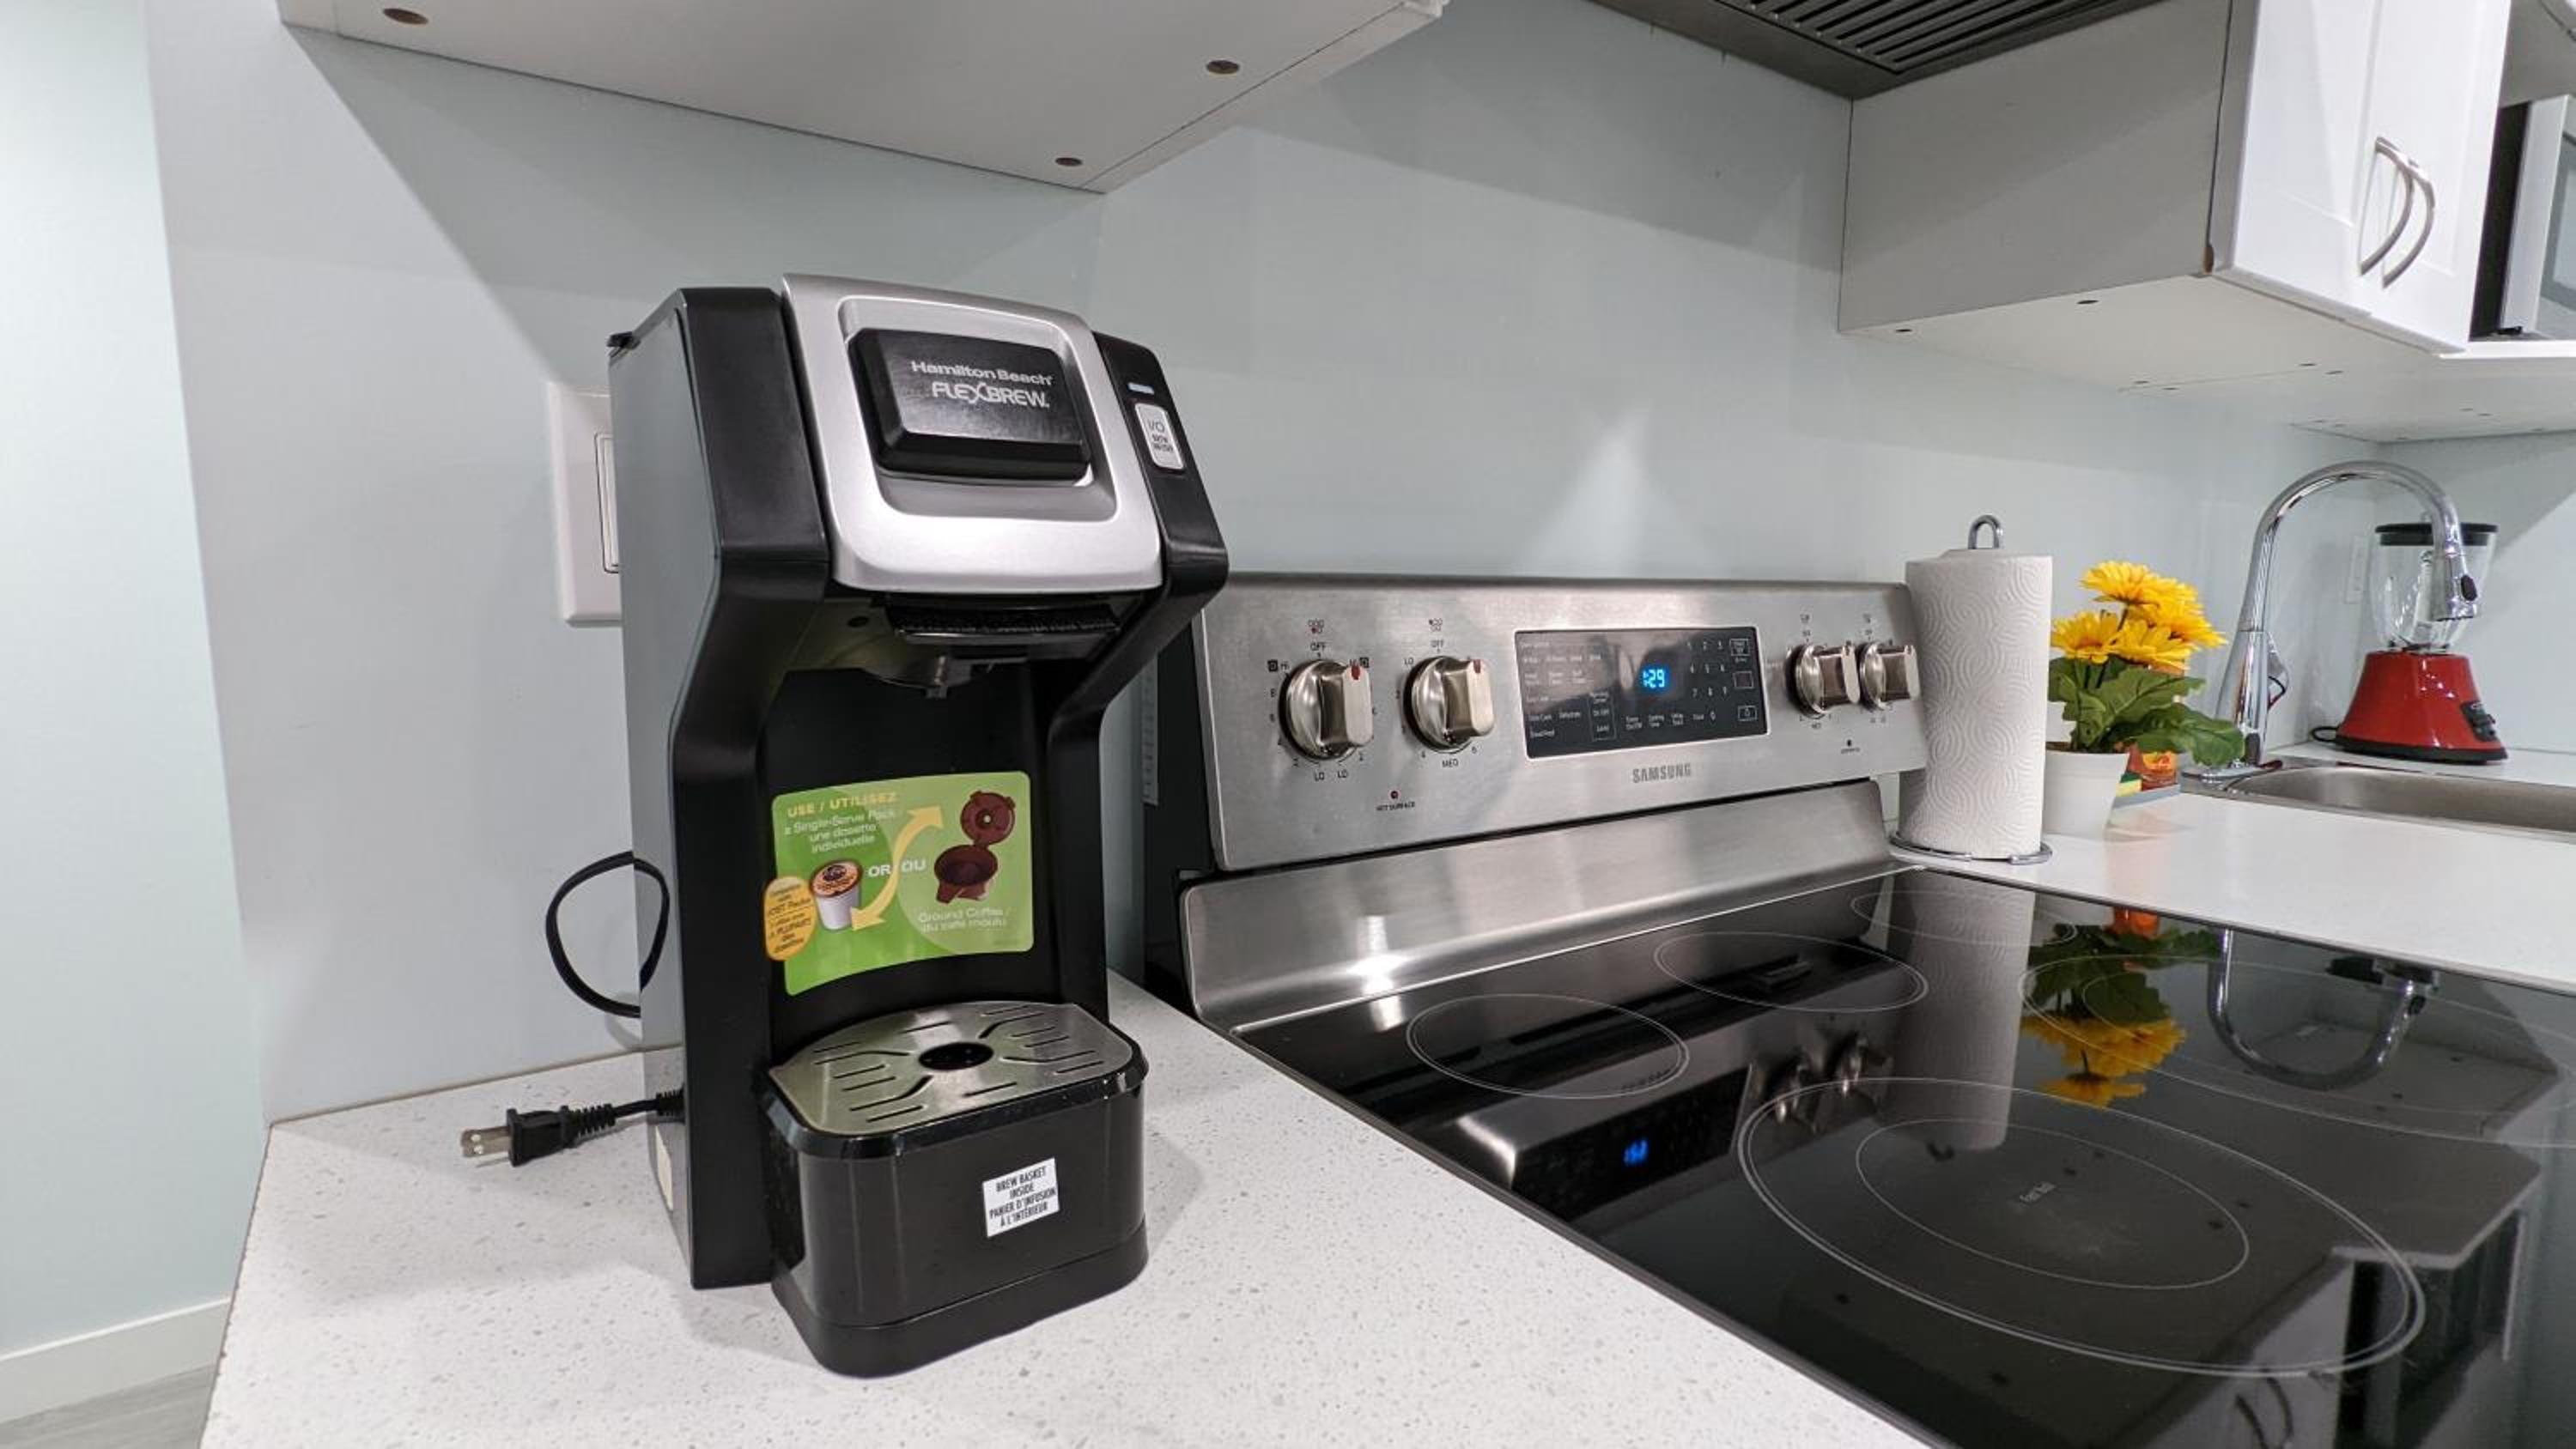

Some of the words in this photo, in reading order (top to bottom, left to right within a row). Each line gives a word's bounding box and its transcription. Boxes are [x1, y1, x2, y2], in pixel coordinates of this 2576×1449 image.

[911, 360, 996, 379] Hamilton
[1632, 763, 1692, 783] SAMSUNG
[787, 803, 815, 818] USE
[867, 864, 891, 877] OR
[902, 858, 927, 873] OU
[996, 1176, 1018, 1192] BREW
[1018, 1165, 1047, 1184] BASKET
[1010, 1181, 1035, 1200] INSIDE
[989, 1201, 1015, 1219] PANIER
